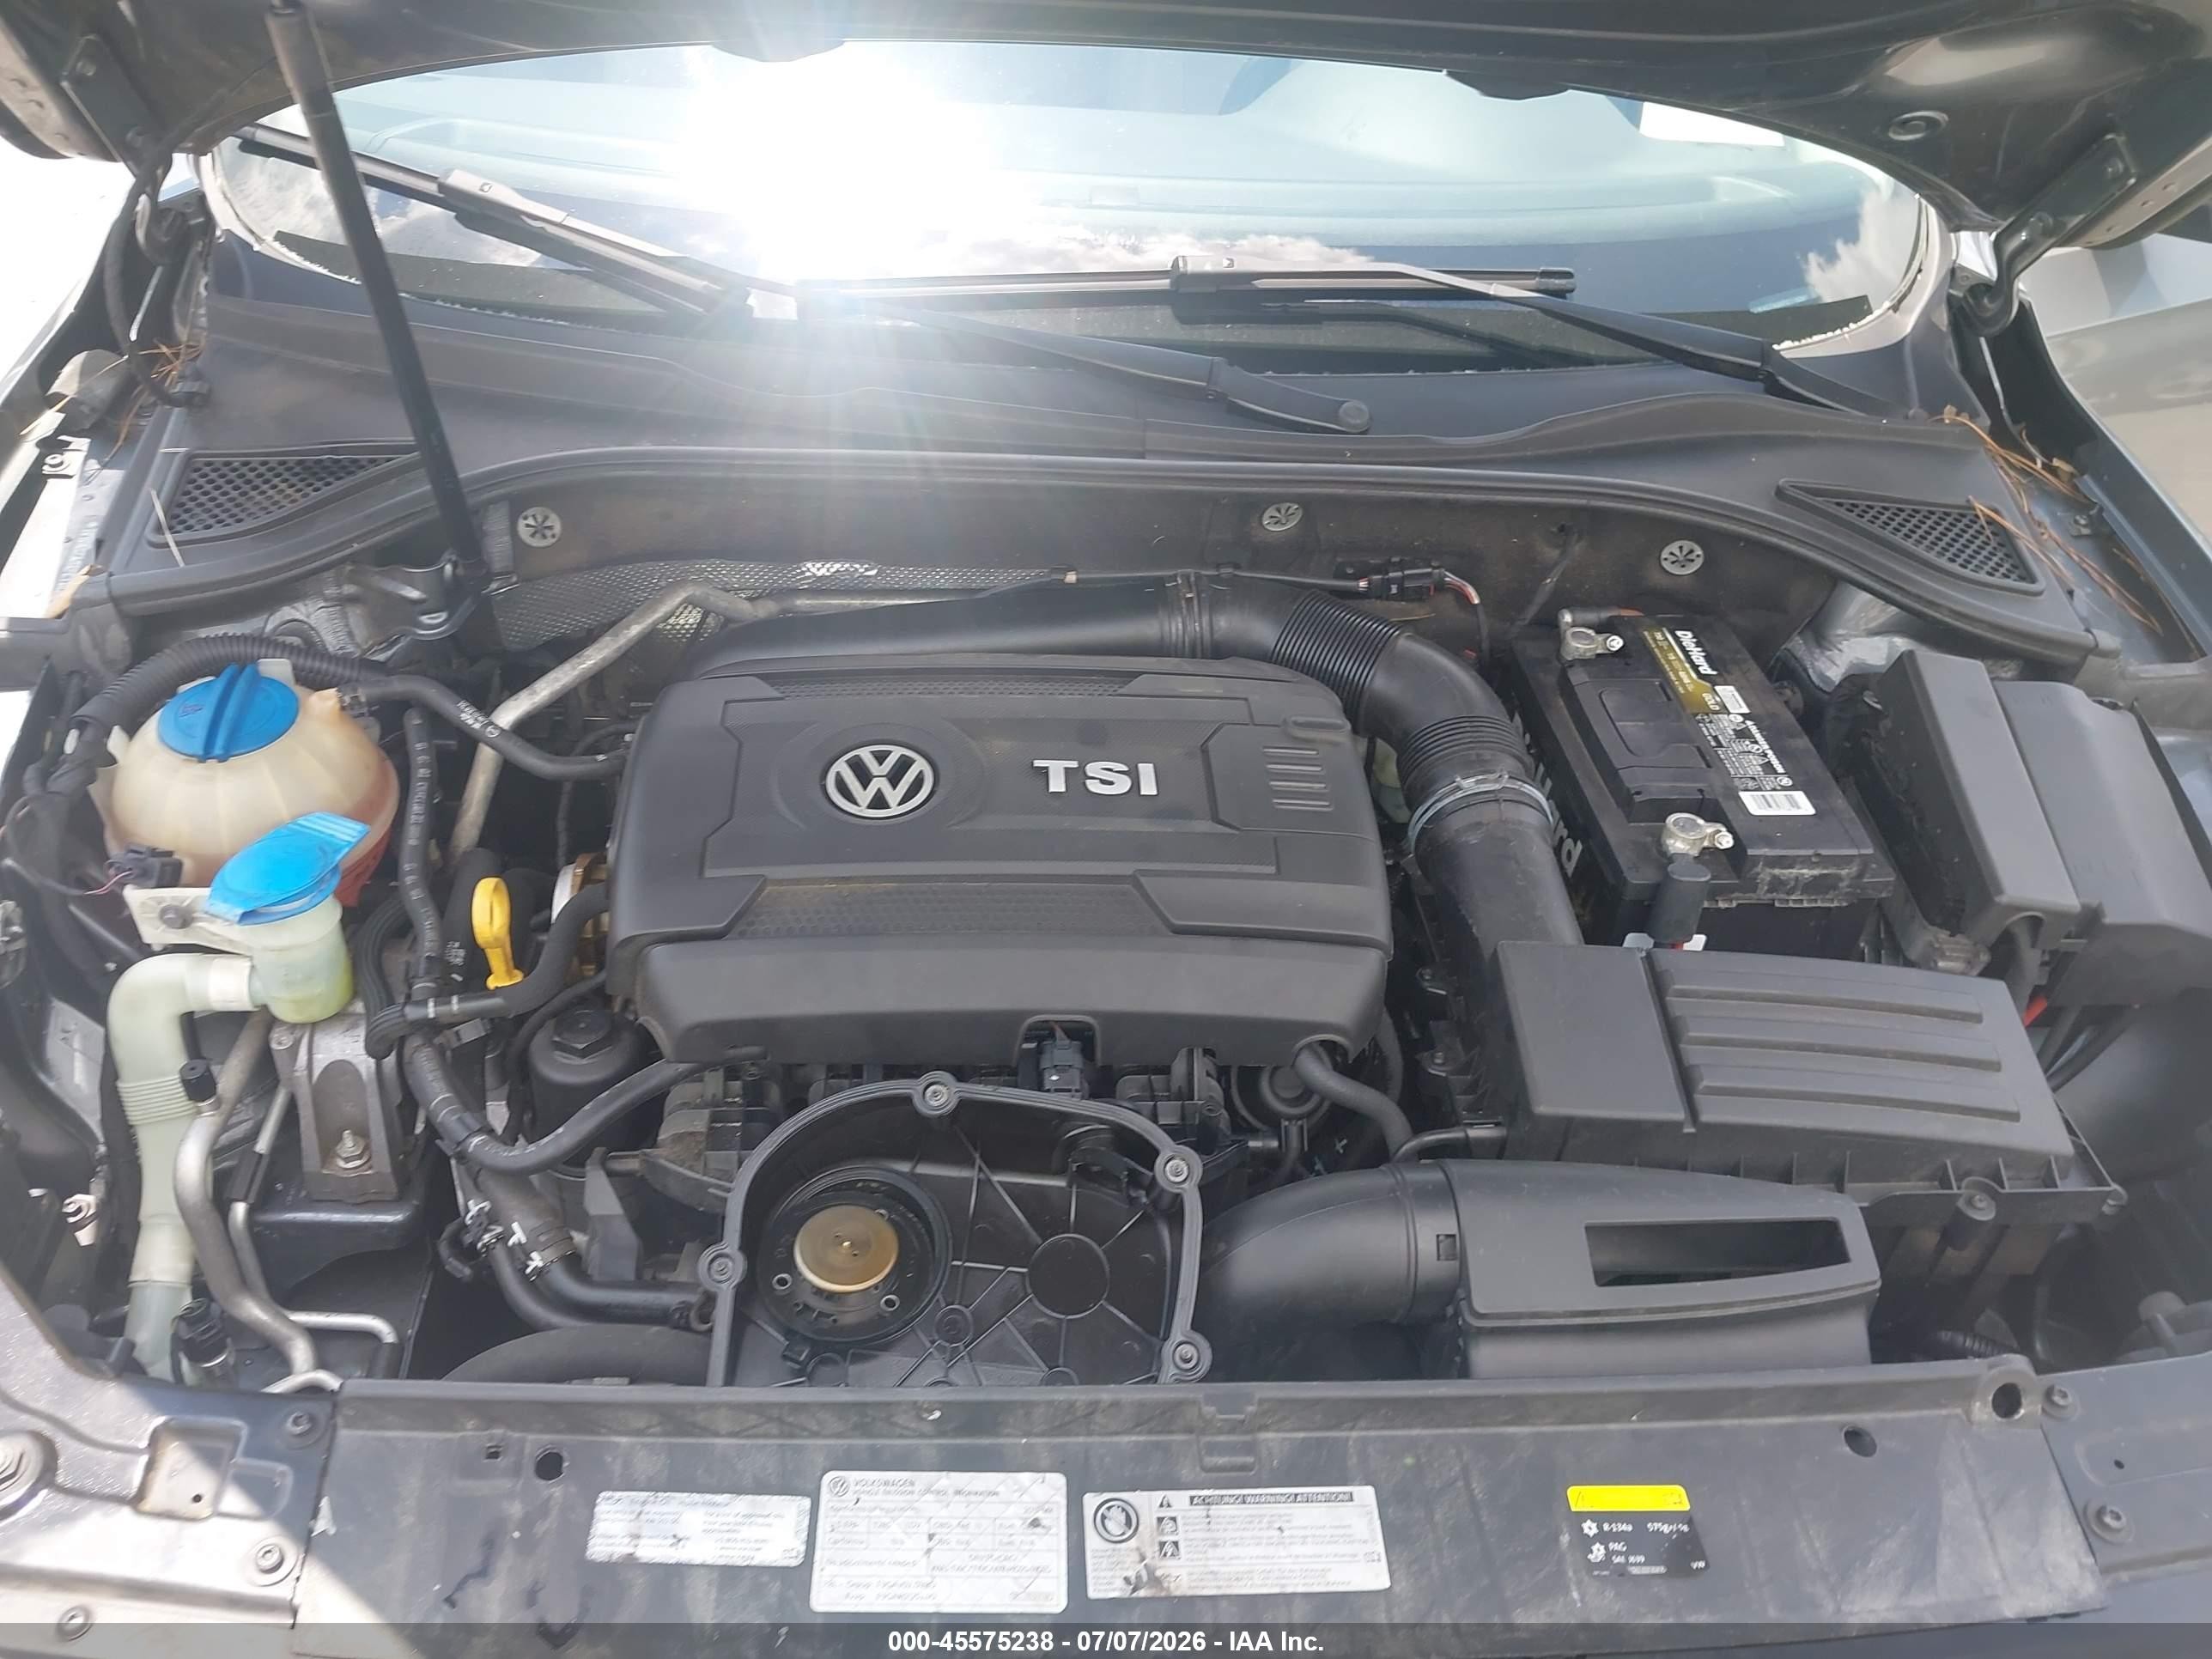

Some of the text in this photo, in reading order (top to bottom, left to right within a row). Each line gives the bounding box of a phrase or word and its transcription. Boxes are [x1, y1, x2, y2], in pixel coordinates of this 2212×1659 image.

[1674, 630, 1718, 675] DieHard
[1702, 693, 1720, 711] GOLD
[826, 744, 934, 817] VW
[1033, 759, 1158, 795] TSI
